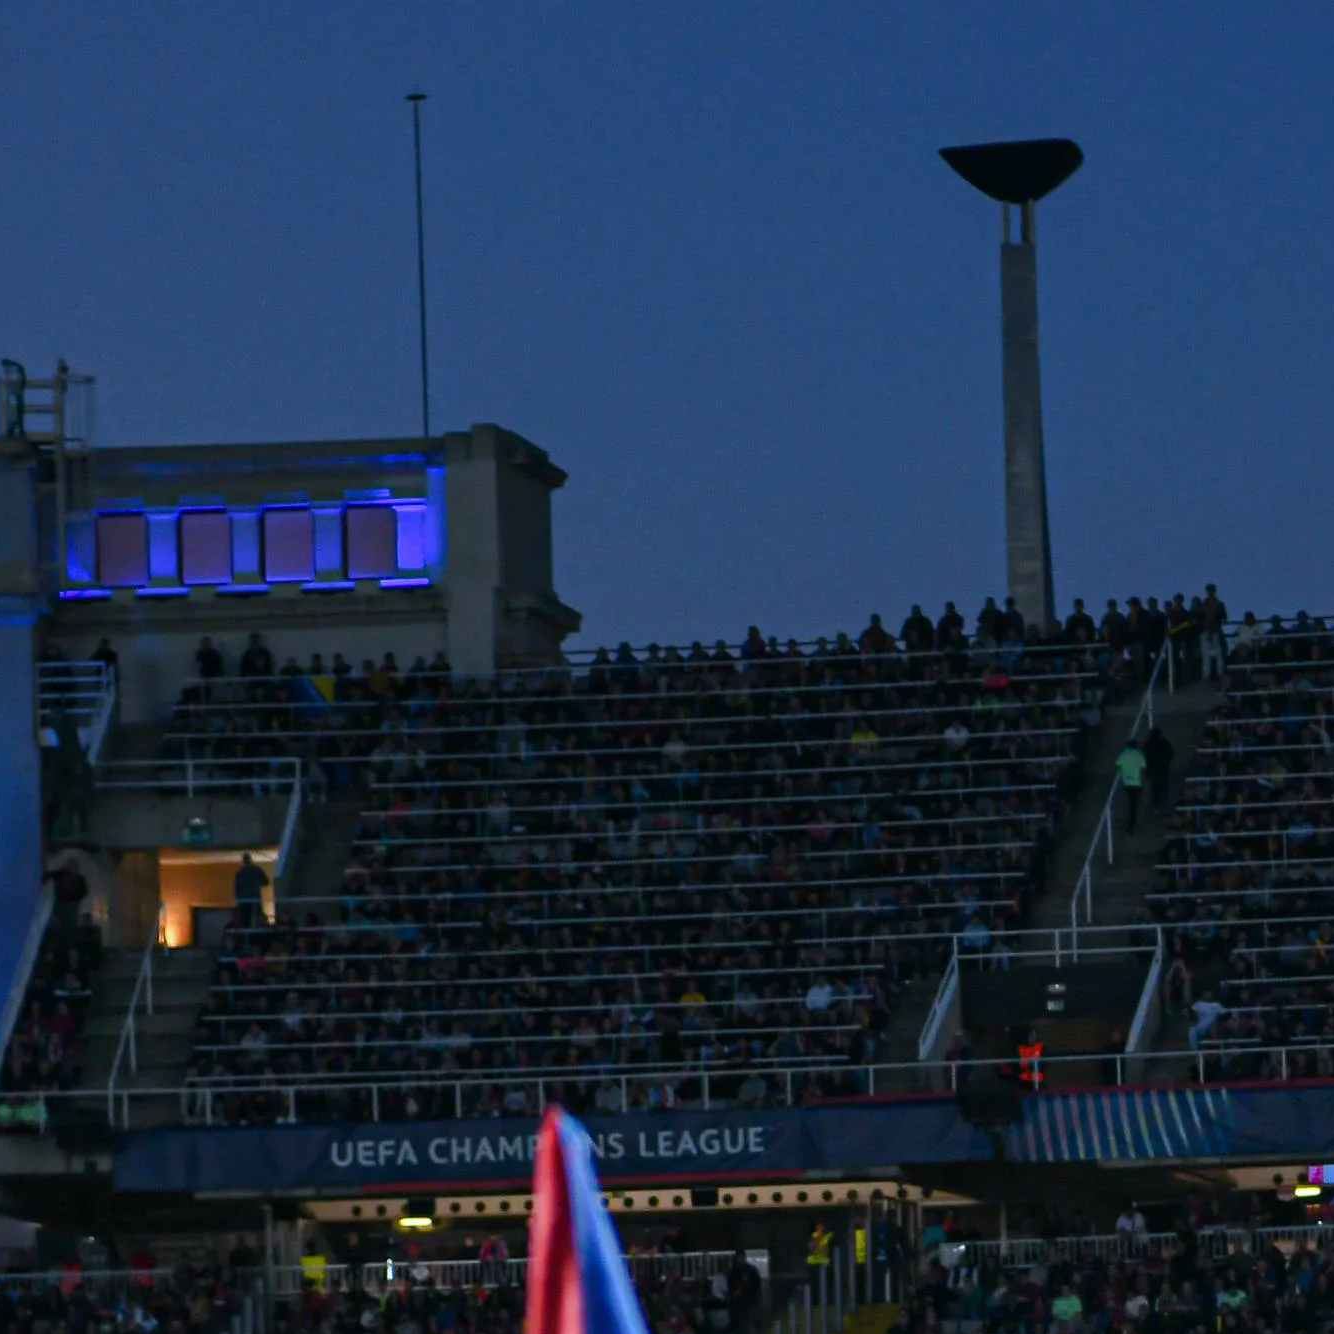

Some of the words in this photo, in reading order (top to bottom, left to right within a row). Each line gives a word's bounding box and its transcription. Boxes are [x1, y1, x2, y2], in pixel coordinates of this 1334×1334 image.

[330, 1139, 419, 1167] UEFA
[428, 1131, 626, 1164] CHAMPNS
[639, 1126, 766, 1159] LEAGUE
